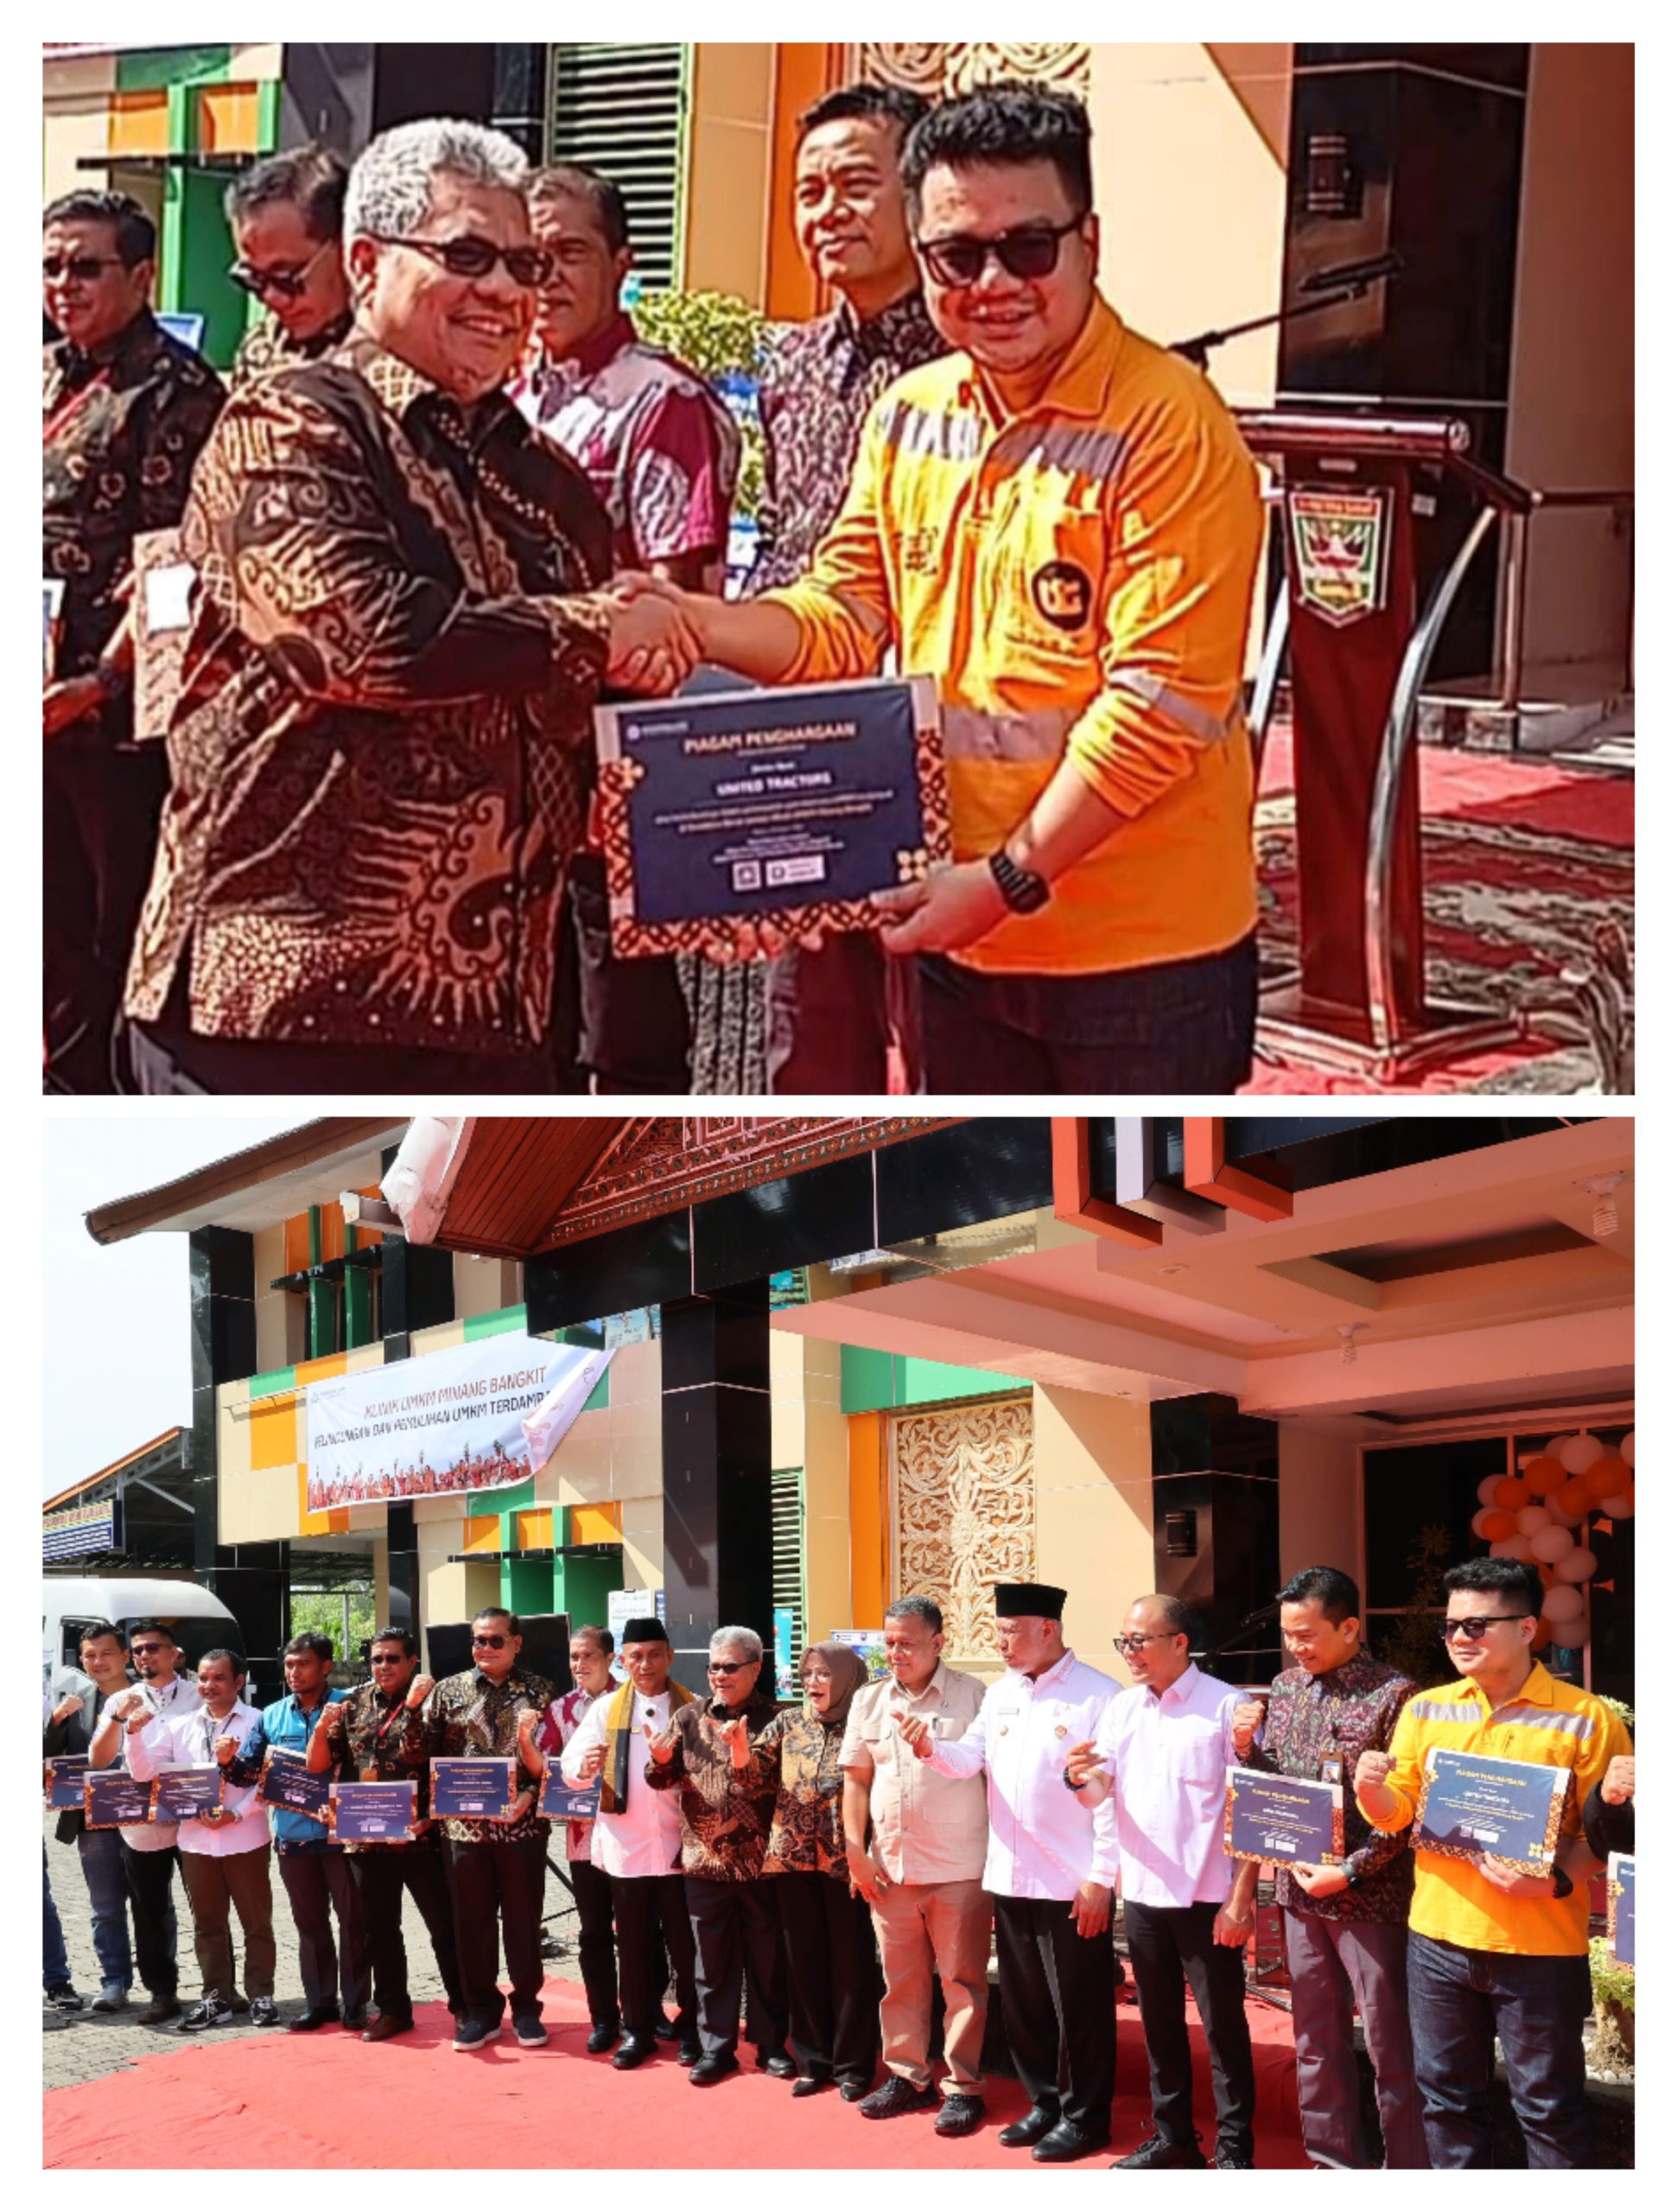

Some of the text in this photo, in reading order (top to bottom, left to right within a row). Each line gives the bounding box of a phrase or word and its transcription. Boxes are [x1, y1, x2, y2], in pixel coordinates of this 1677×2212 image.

[683, 734, 742, 754] PIAGAM
[716, 779, 764, 796] UNITED
[401, 1390, 436, 1411] UMKM
[438, 1380, 487, 1403] MINANG
[490, 1365, 547, 1394] BANGKIT
[372, 1421, 391, 1436] DAN
[452, 1403, 487, 1421] UMKM
